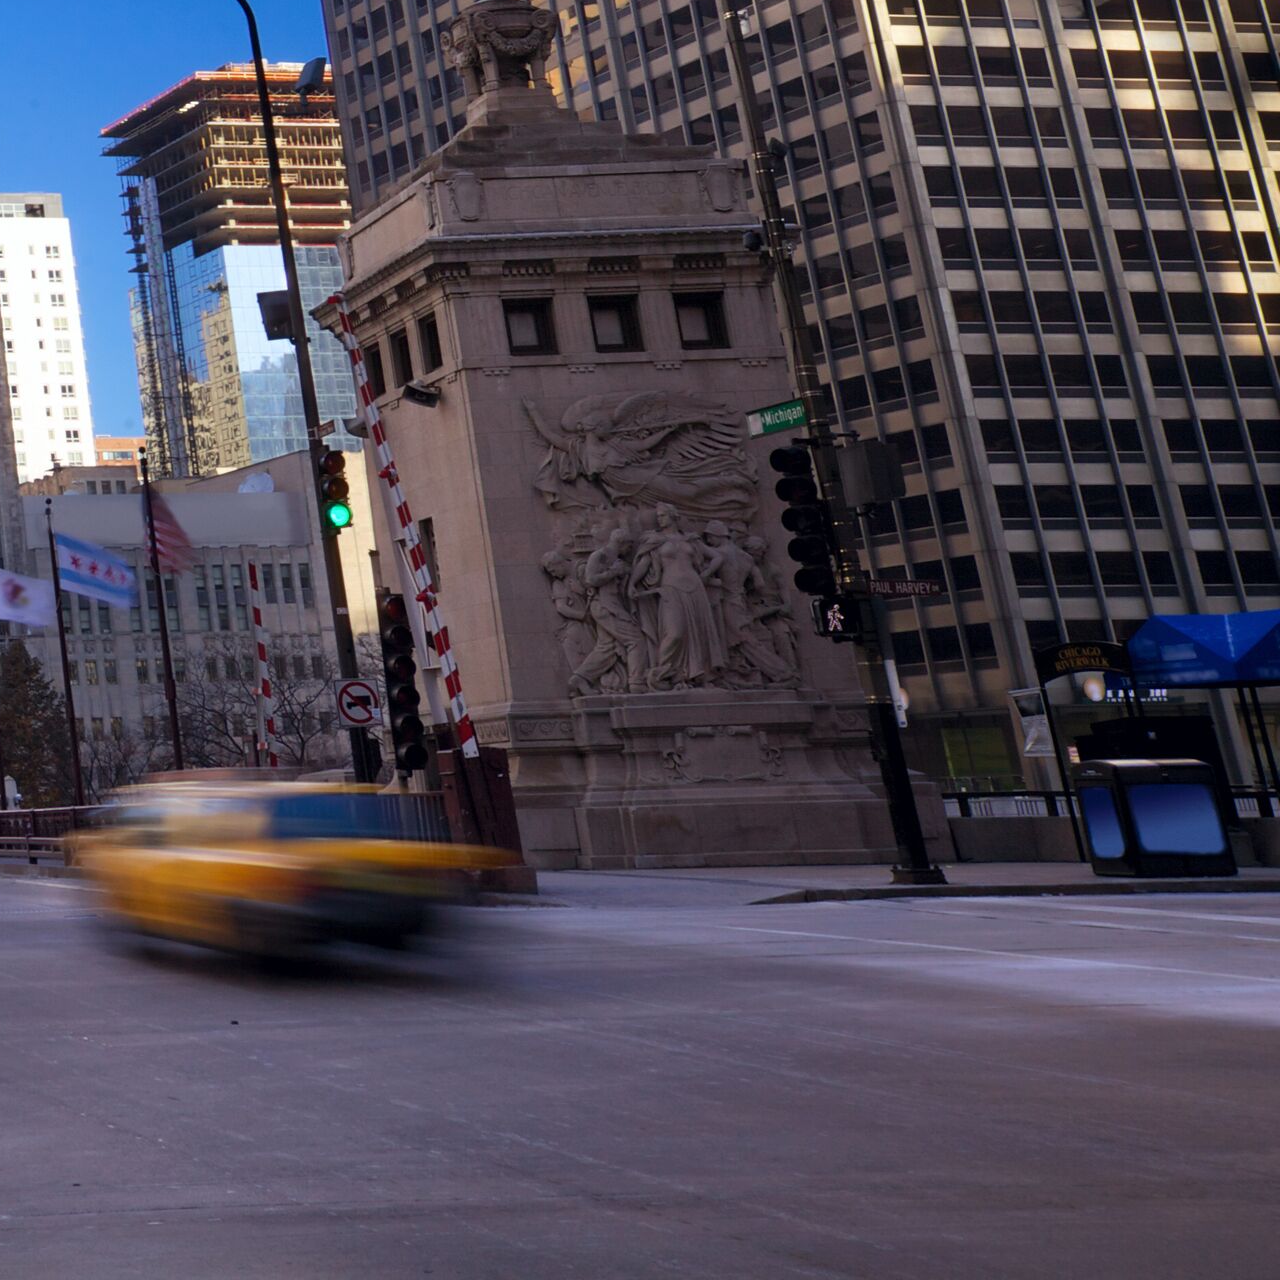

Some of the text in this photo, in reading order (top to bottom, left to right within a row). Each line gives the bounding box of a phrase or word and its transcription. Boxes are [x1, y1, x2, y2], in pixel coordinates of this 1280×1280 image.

[764, 406, 802, 426] Michigan
[870, 581, 893, 594] PAUL
[895, 581, 931, 595] HARVEY
[1058, 646, 1101, 659] CHICAGO
[1055, 657, 1110, 672] RIVERWALK
